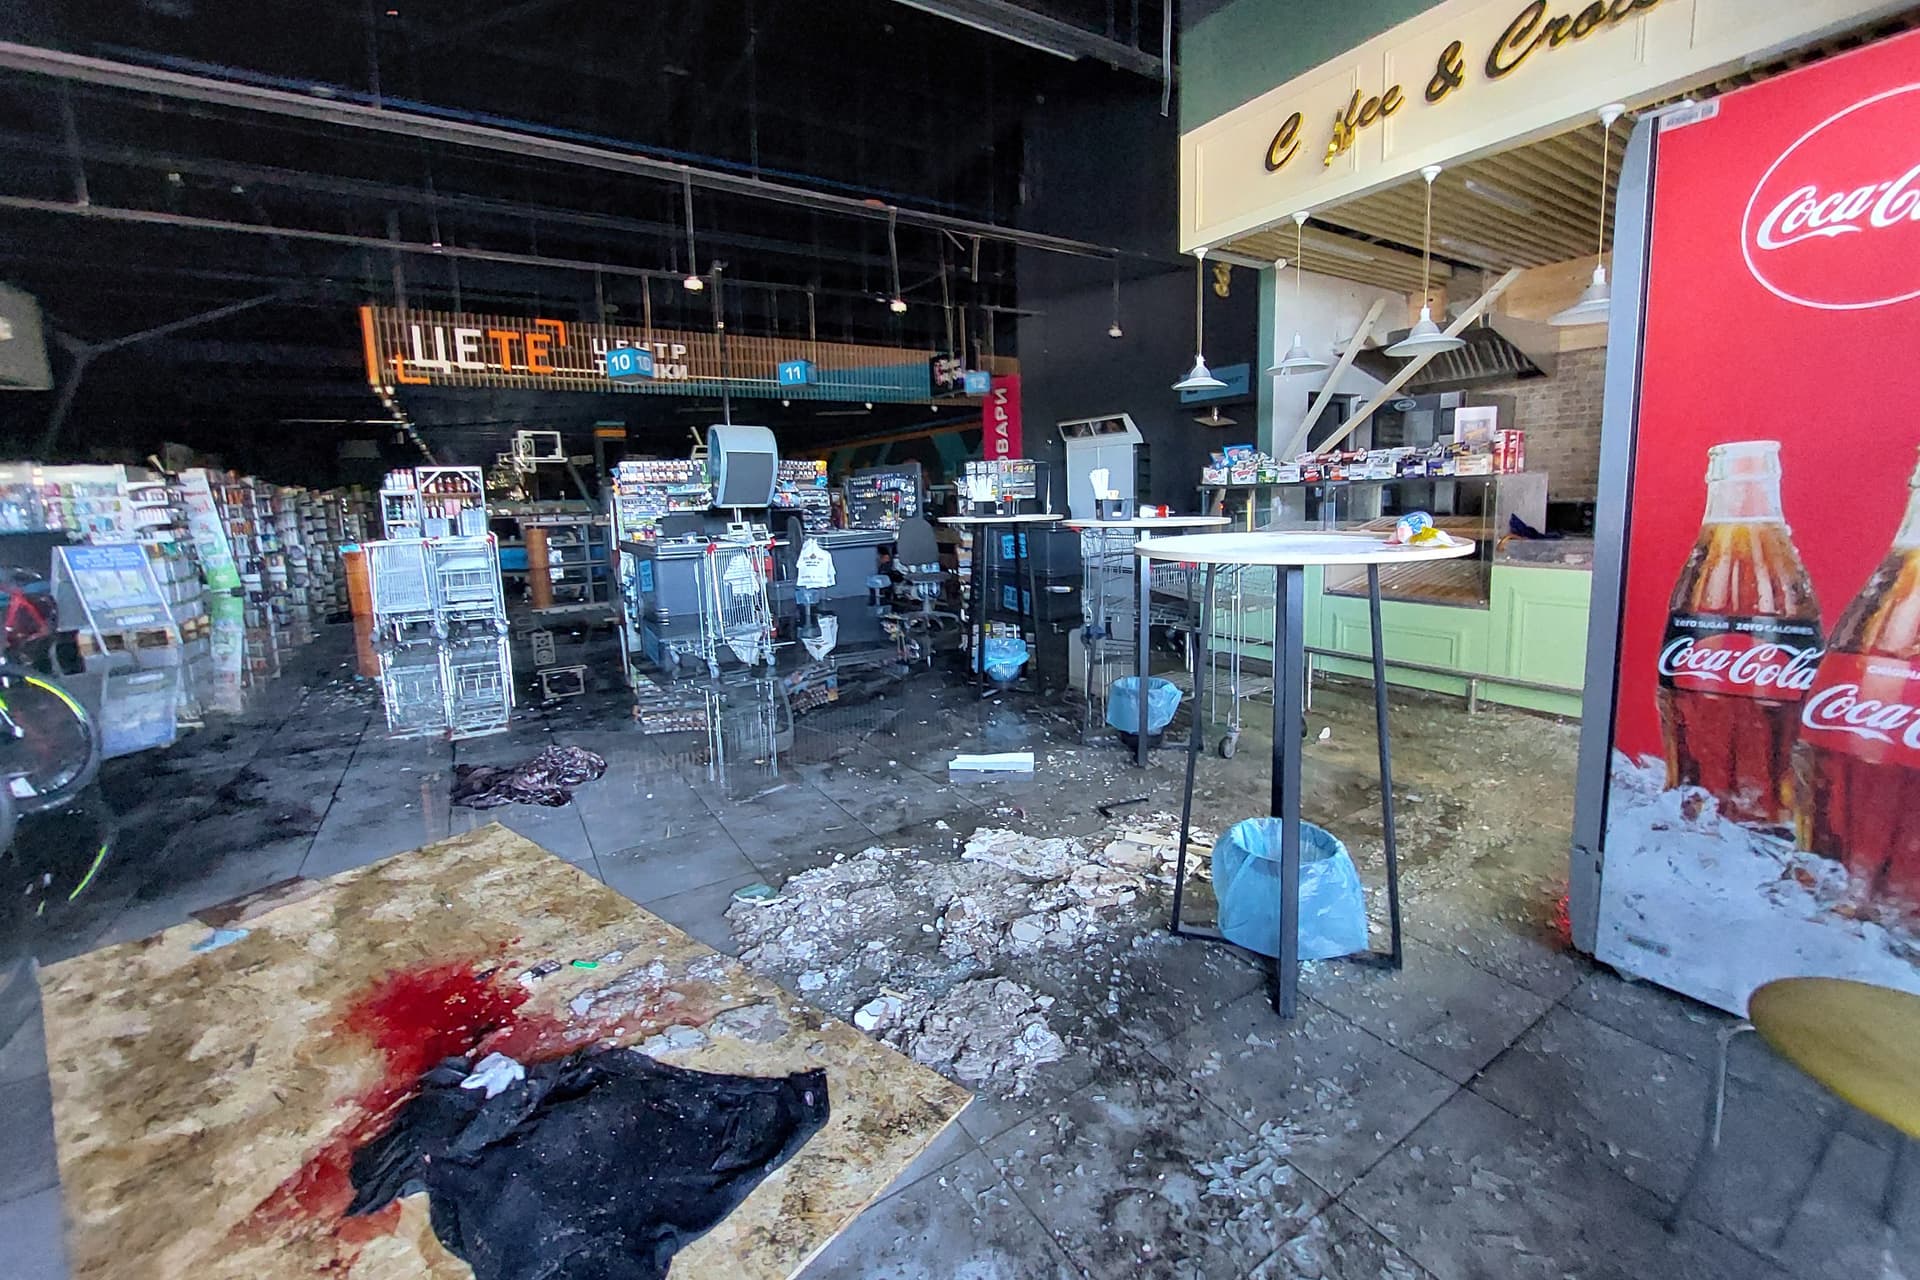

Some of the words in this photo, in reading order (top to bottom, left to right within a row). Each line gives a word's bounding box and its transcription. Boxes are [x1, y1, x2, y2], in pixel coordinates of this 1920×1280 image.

[1425, 40, 1464, 103] &
[411, 325, 554, 375] ЦЕТЕ
[611, 354, 630, 371] 10
[785, 366, 801, 381] 11
[1658, 637, 1826, 691] Coca-Cola
